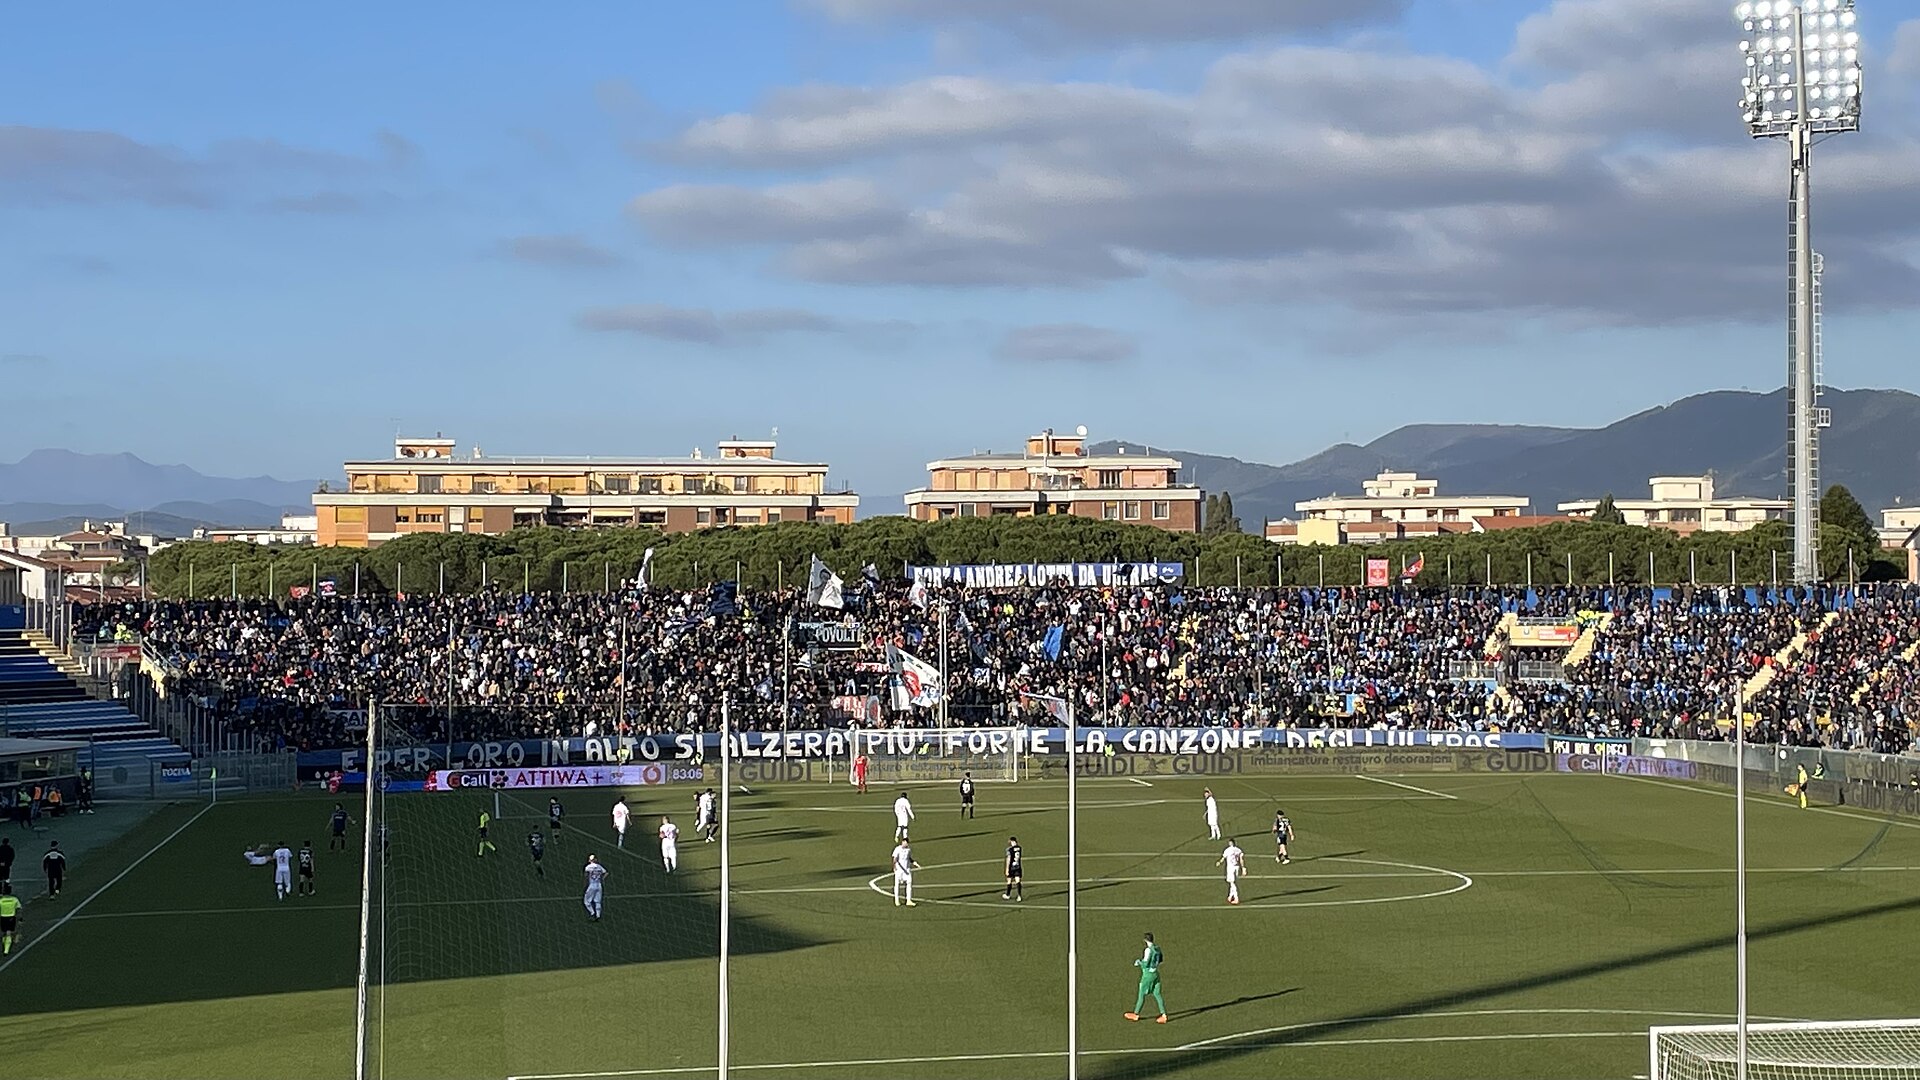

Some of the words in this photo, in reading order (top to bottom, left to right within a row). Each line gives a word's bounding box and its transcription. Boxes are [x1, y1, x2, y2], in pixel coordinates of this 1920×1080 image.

[966, 566, 1024, 588] ANDREA
[1028, 565, 1074, 587] LOTTA
[1078, 565, 1097, 586] DA
[541, 738, 569, 764] IN
[585, 735, 659, 762] ALTO
[675, 734, 704, 759] SI
[1122, 728, 1262, 755] CANZONE
[739, 759, 813, 782] GUIDI
[1173, 755, 1243, 774] GUIDI
